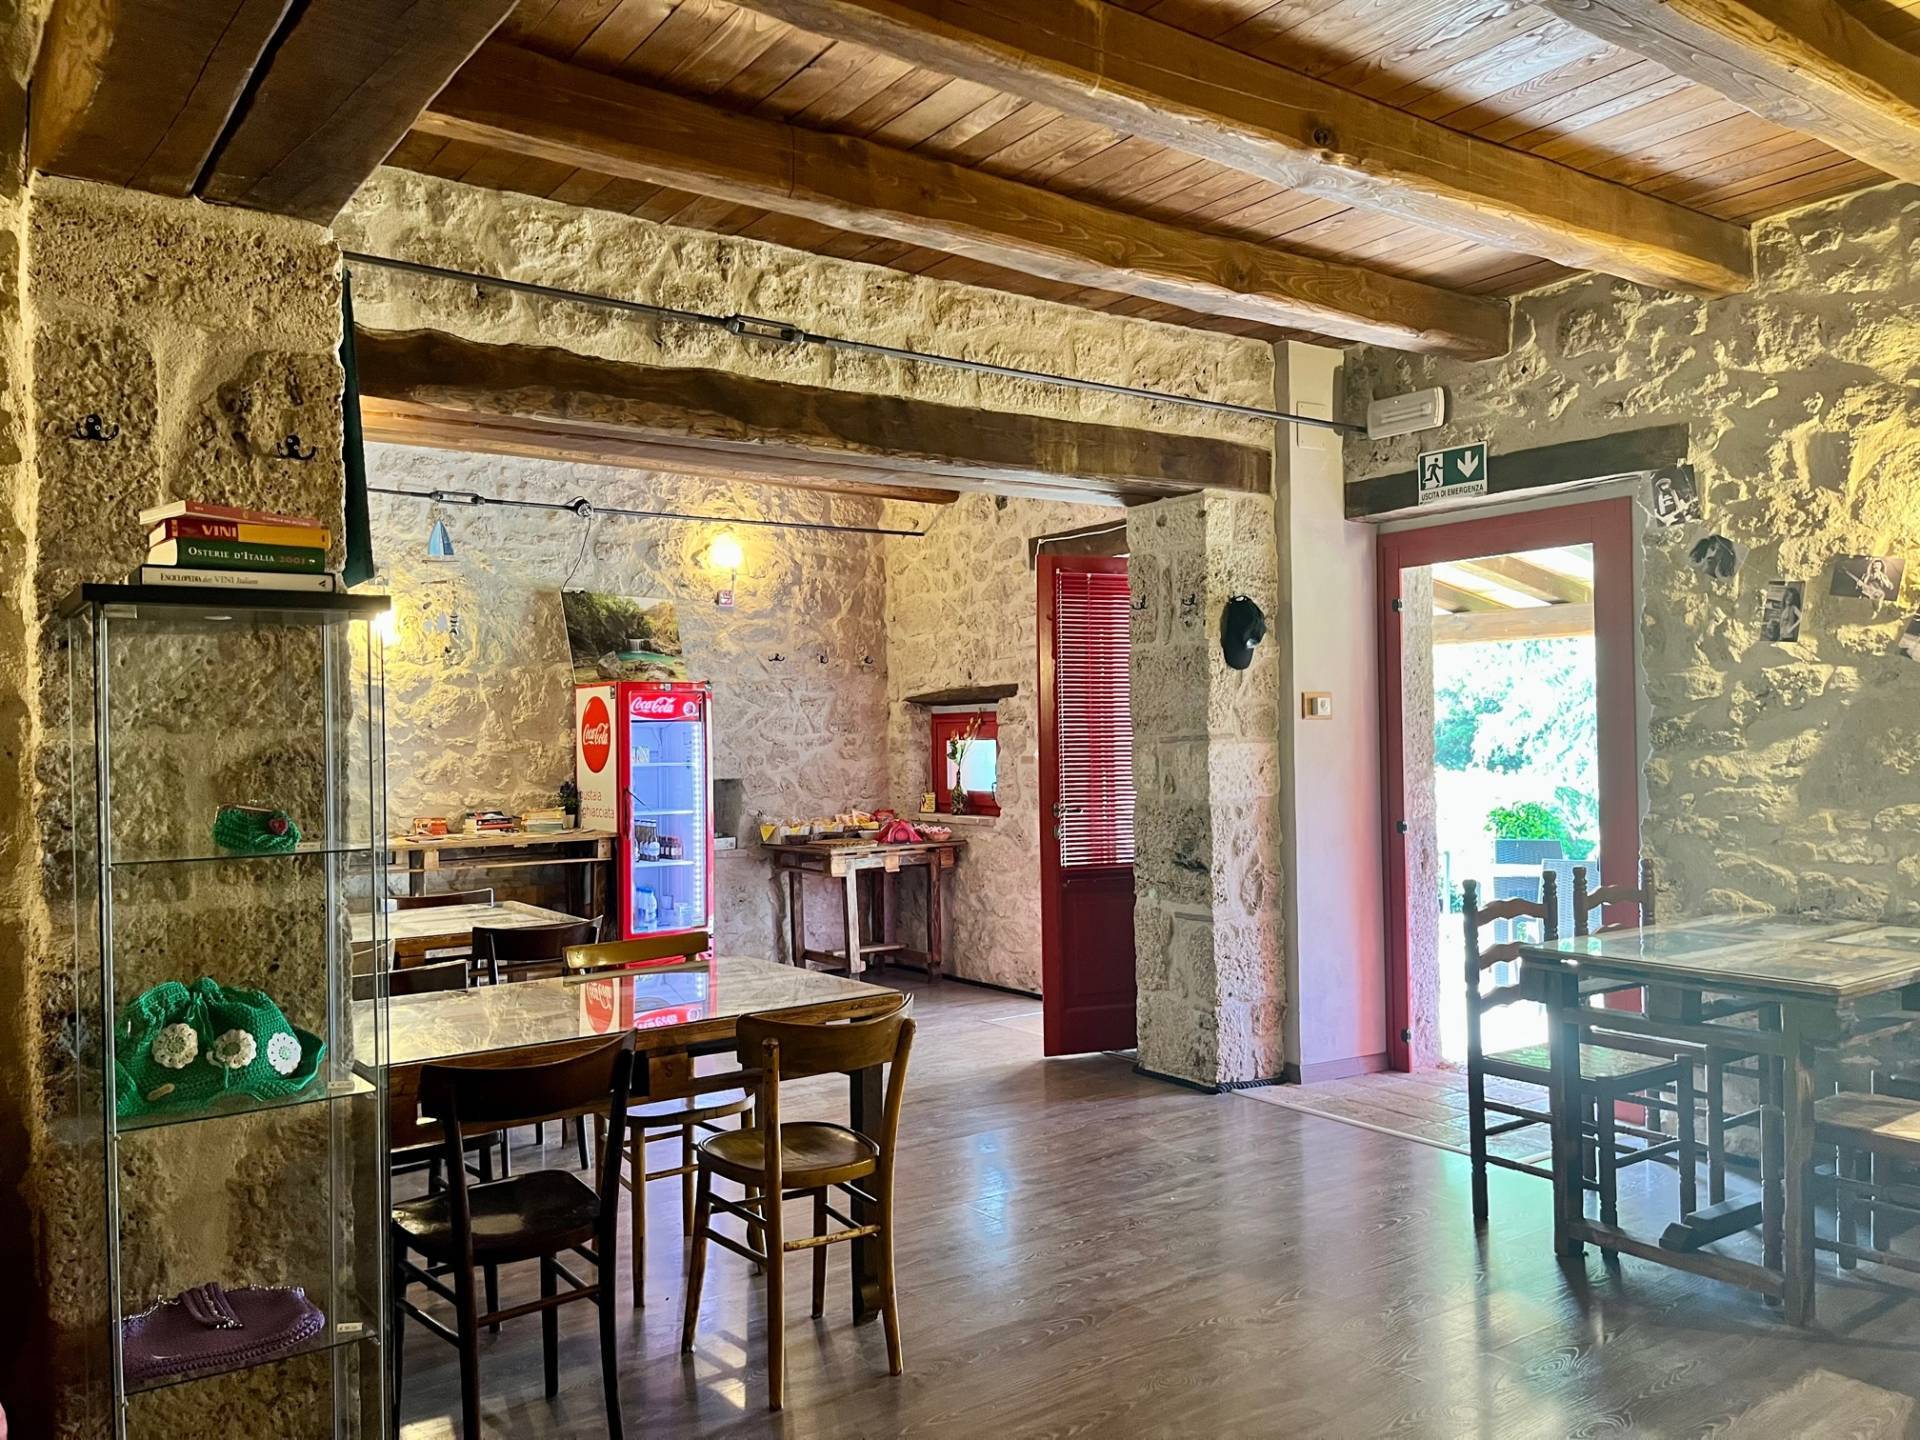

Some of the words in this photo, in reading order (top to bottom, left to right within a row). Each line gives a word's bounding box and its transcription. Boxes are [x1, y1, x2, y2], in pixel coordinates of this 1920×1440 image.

[1421, 491, 1440, 501] USCITA
[1440, 489, 1447, 497] DI
[1447, 484, 1484, 496] EMERGENZA
[201, 524, 237, 537] VINI
[214, 576, 235, 585] VINI
